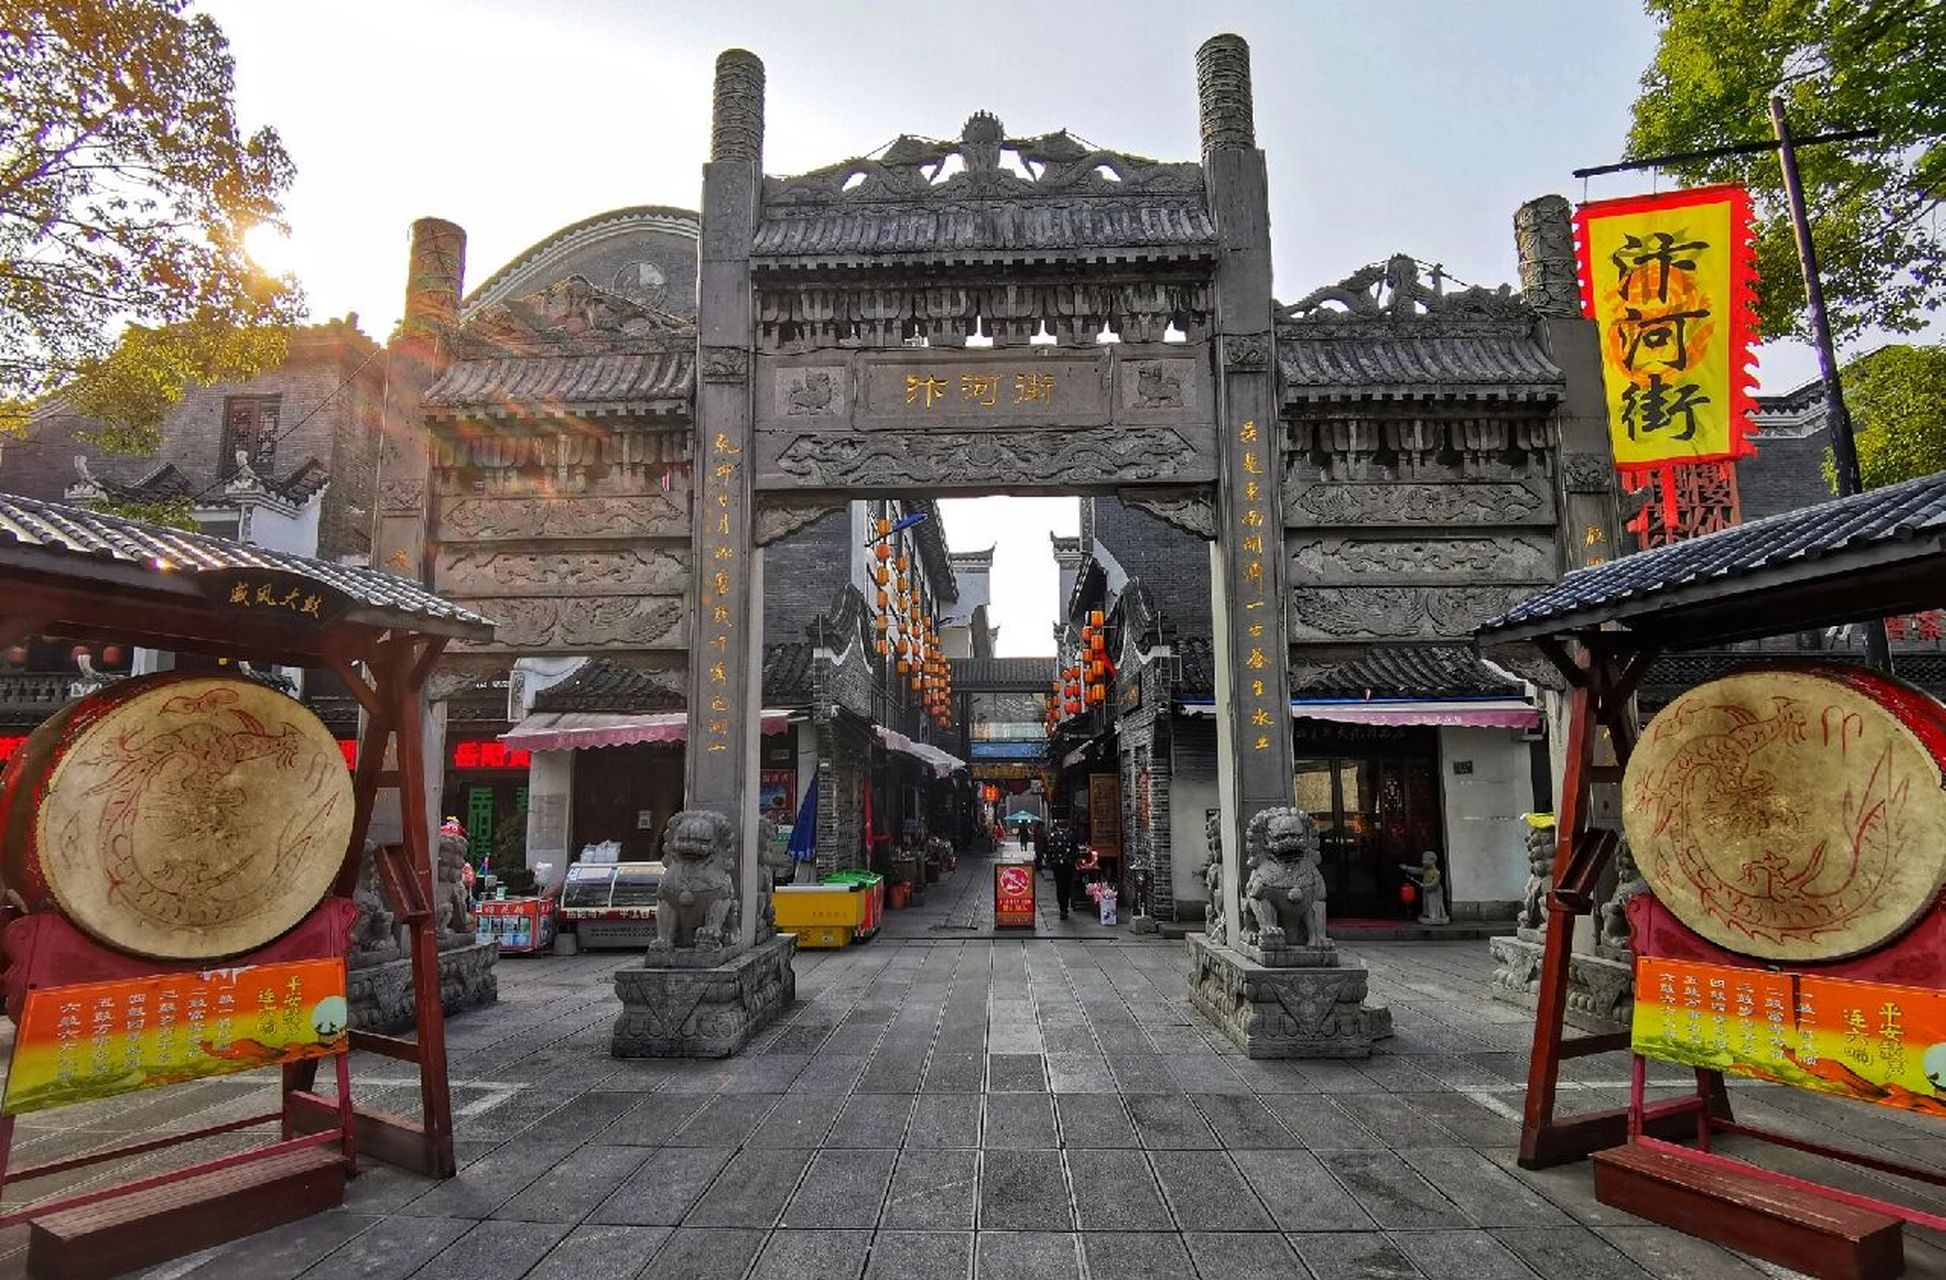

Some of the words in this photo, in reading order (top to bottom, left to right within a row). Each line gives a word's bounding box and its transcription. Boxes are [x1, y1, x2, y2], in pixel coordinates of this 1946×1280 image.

[904, 371, 1057, 409] 汴河街
[1611, 231, 1711, 441] 汴河街
